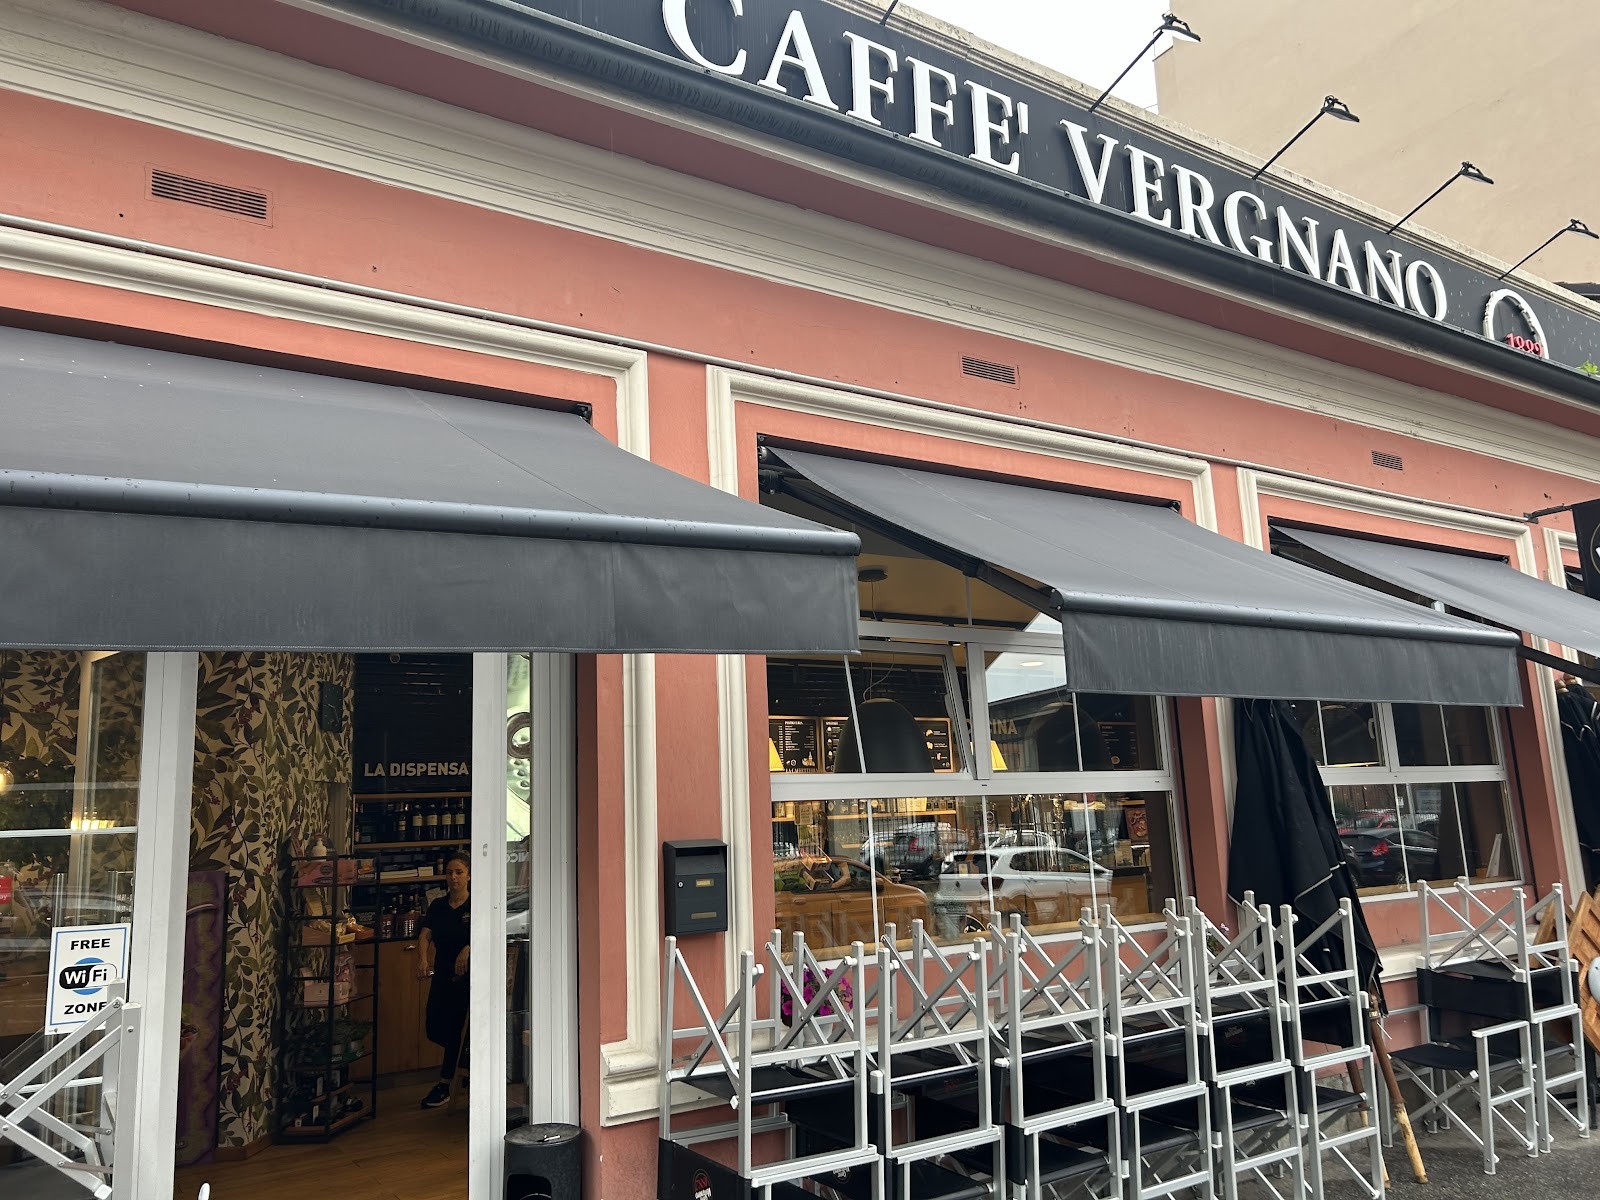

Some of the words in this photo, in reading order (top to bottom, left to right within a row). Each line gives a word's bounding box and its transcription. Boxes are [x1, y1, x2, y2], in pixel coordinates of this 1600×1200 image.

[662, 0, 1028, 174] CAFFE'
[1060, 119, 1447, 321] VERGNANO
[364, 763, 385, 777] LA
[389, 762, 469, 777] DISPENSA
[70, 938, 111, 951] FREE
